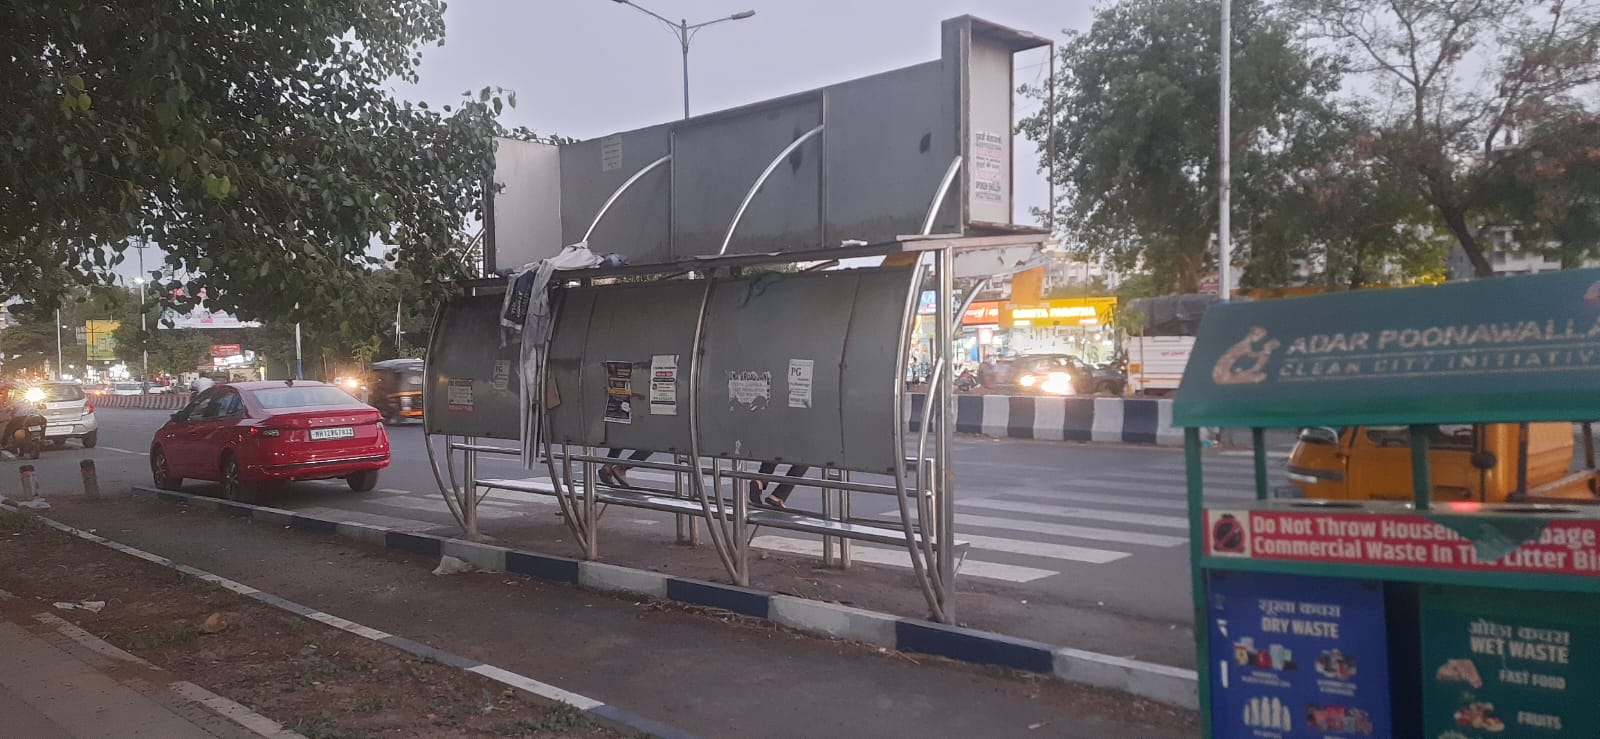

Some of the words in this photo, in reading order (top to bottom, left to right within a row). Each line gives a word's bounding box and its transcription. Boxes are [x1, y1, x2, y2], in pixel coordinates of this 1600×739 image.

[1286, 332, 1370, 355] ADAR
[791, 366, 802, 377] PG
[1280, 361, 1361, 377] CLEAN
[1374, 357, 1434, 373] CITY
[1448, 349, 1600, 369] INITIATIV
[1252, 516, 1276, 534] Do
[1280, 517, 1313, 536] Not
[1315, 517, 1376, 538] Throw
[1254, 536, 1361, 559] Commercial
[1366, 541, 1427, 562] Waste
[1433, 545, 1453, 563] In
[1572, 549, 1600, 571] Bi
[1261, 616, 1289, 634] DRY
[1291, 618, 1340, 639] WASTE
[1469, 636, 1505, 656] WET
[1509, 640, 1570, 664] WASTE
[1498, 669, 1530, 685] FAST
[1531, 673, 1566, 690] FOOD
[1517, 711, 1563, 730] FRUITS
